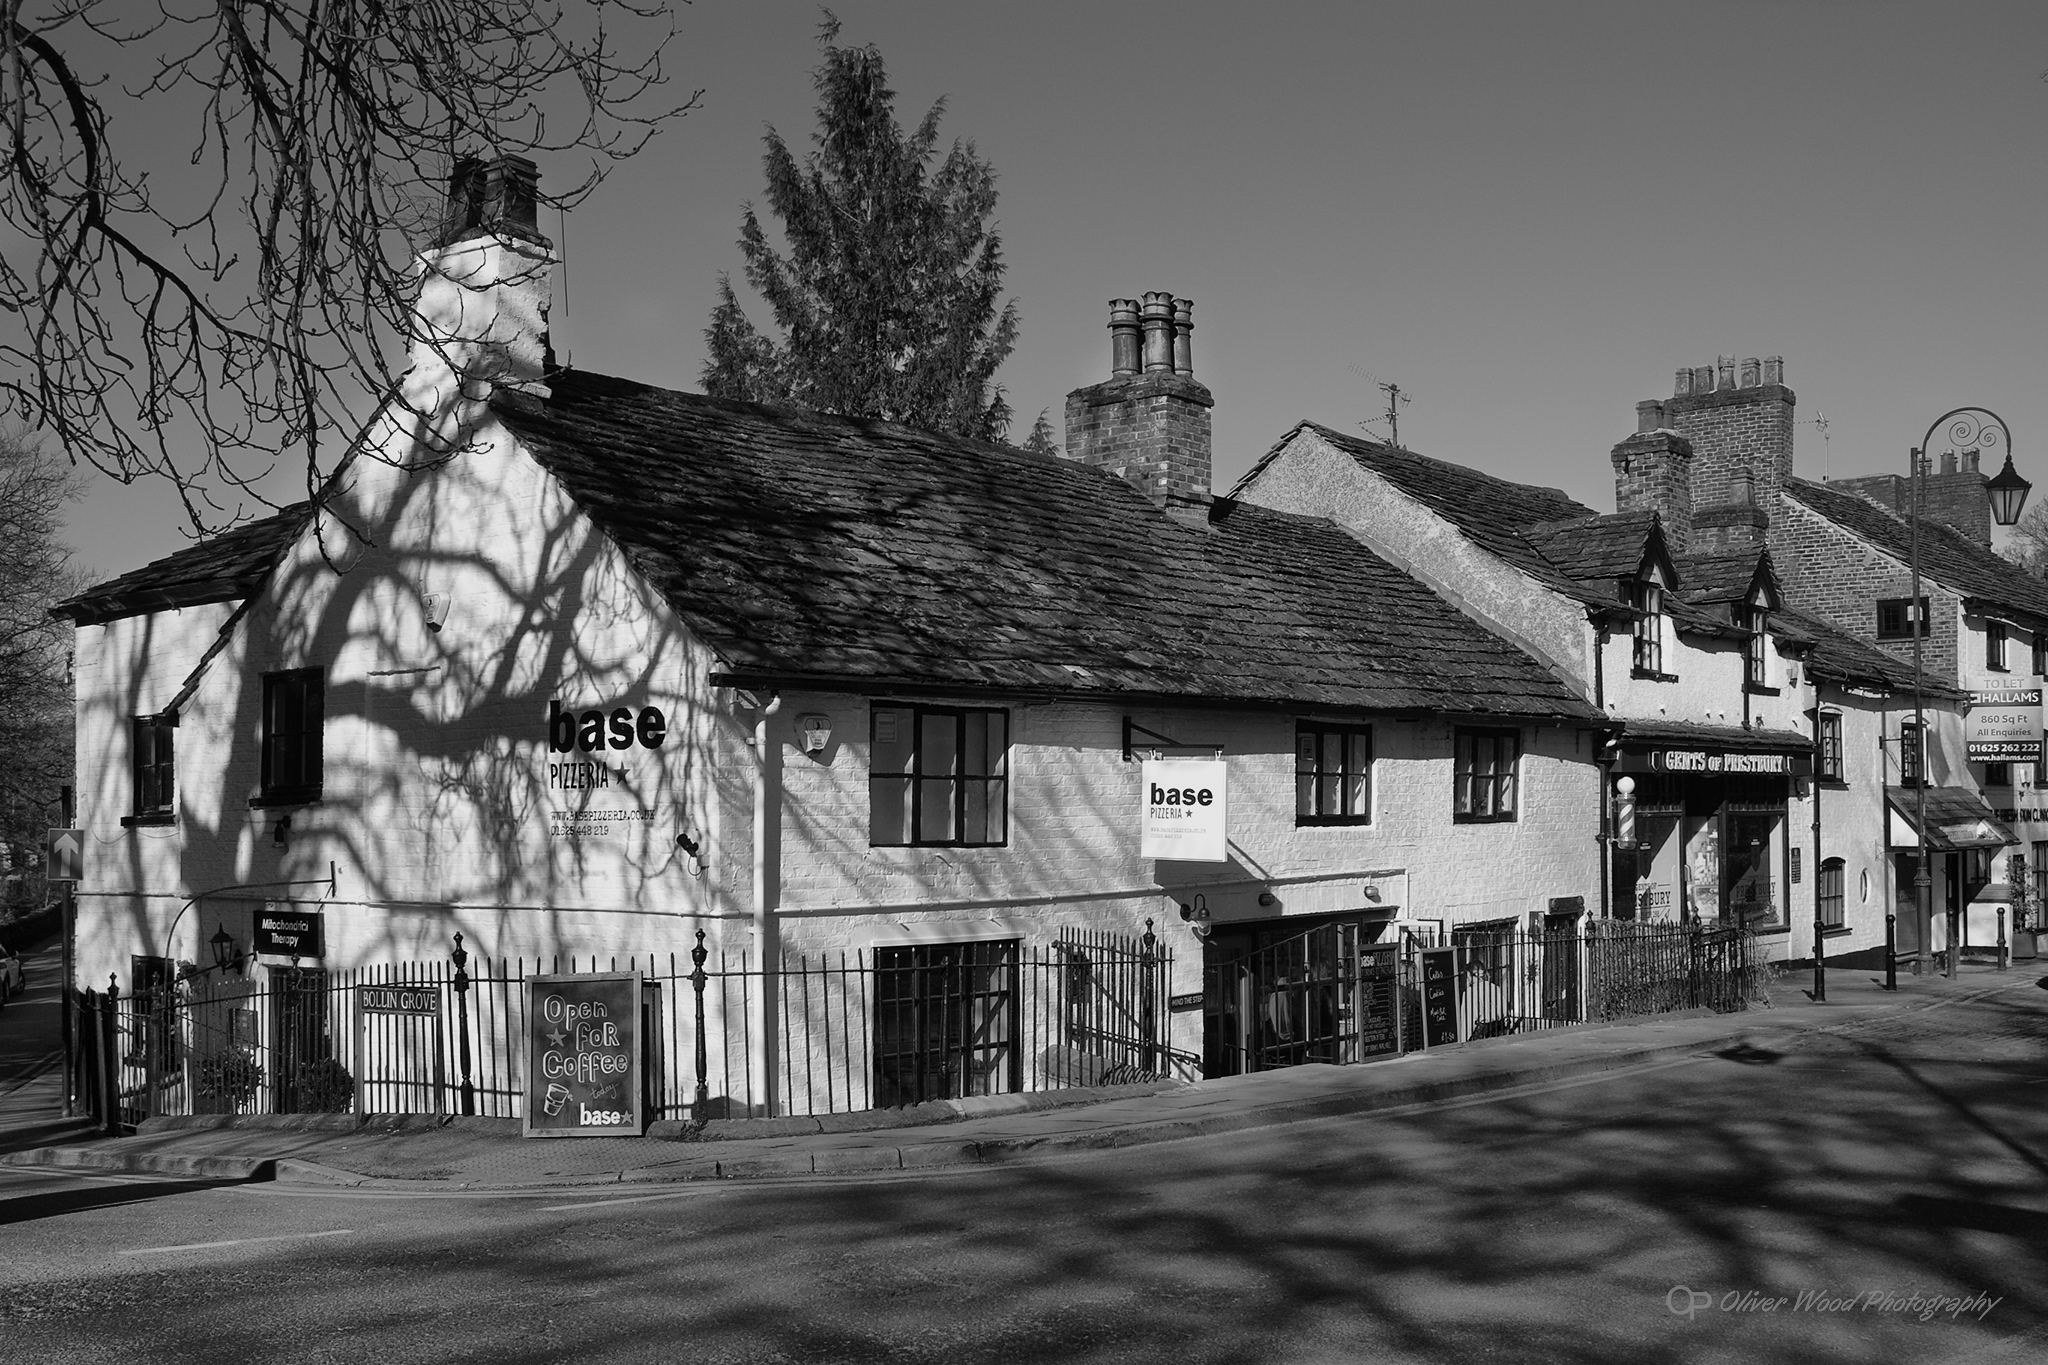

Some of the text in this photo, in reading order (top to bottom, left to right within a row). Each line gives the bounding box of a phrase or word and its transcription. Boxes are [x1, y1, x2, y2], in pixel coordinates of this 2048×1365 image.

[1983, 678, 2024, 689] TO LET
[1982, 692, 2039, 703] HALLAMS
[549, 700, 666, 753] base
[1981, 715, 2027, 725] 860 Sq Ft
[1991, 728, 2031, 737] Enquiries
[1969, 743, 2040, 752] 01625 262 222
[1666, 751, 1706, 771] GENTS
[1724, 753, 1783, 772] PRESTBURY
[551, 761, 609, 789] PIZZERIA
[1150, 782, 1213, 806] base
[1150, 807, 1182, 819] PIZZERIA
[271, 932, 299, 947] Therapy
[363, 990, 436, 1011] BOLLIN GROVE
[1184, 996, 1192, 1005] THE
[544, 995, 607, 1031] Open
[542, 1050, 628, 1083] Coffee
[590, 1083, 617, 1099] today
[580, 1102, 620, 1125] base
